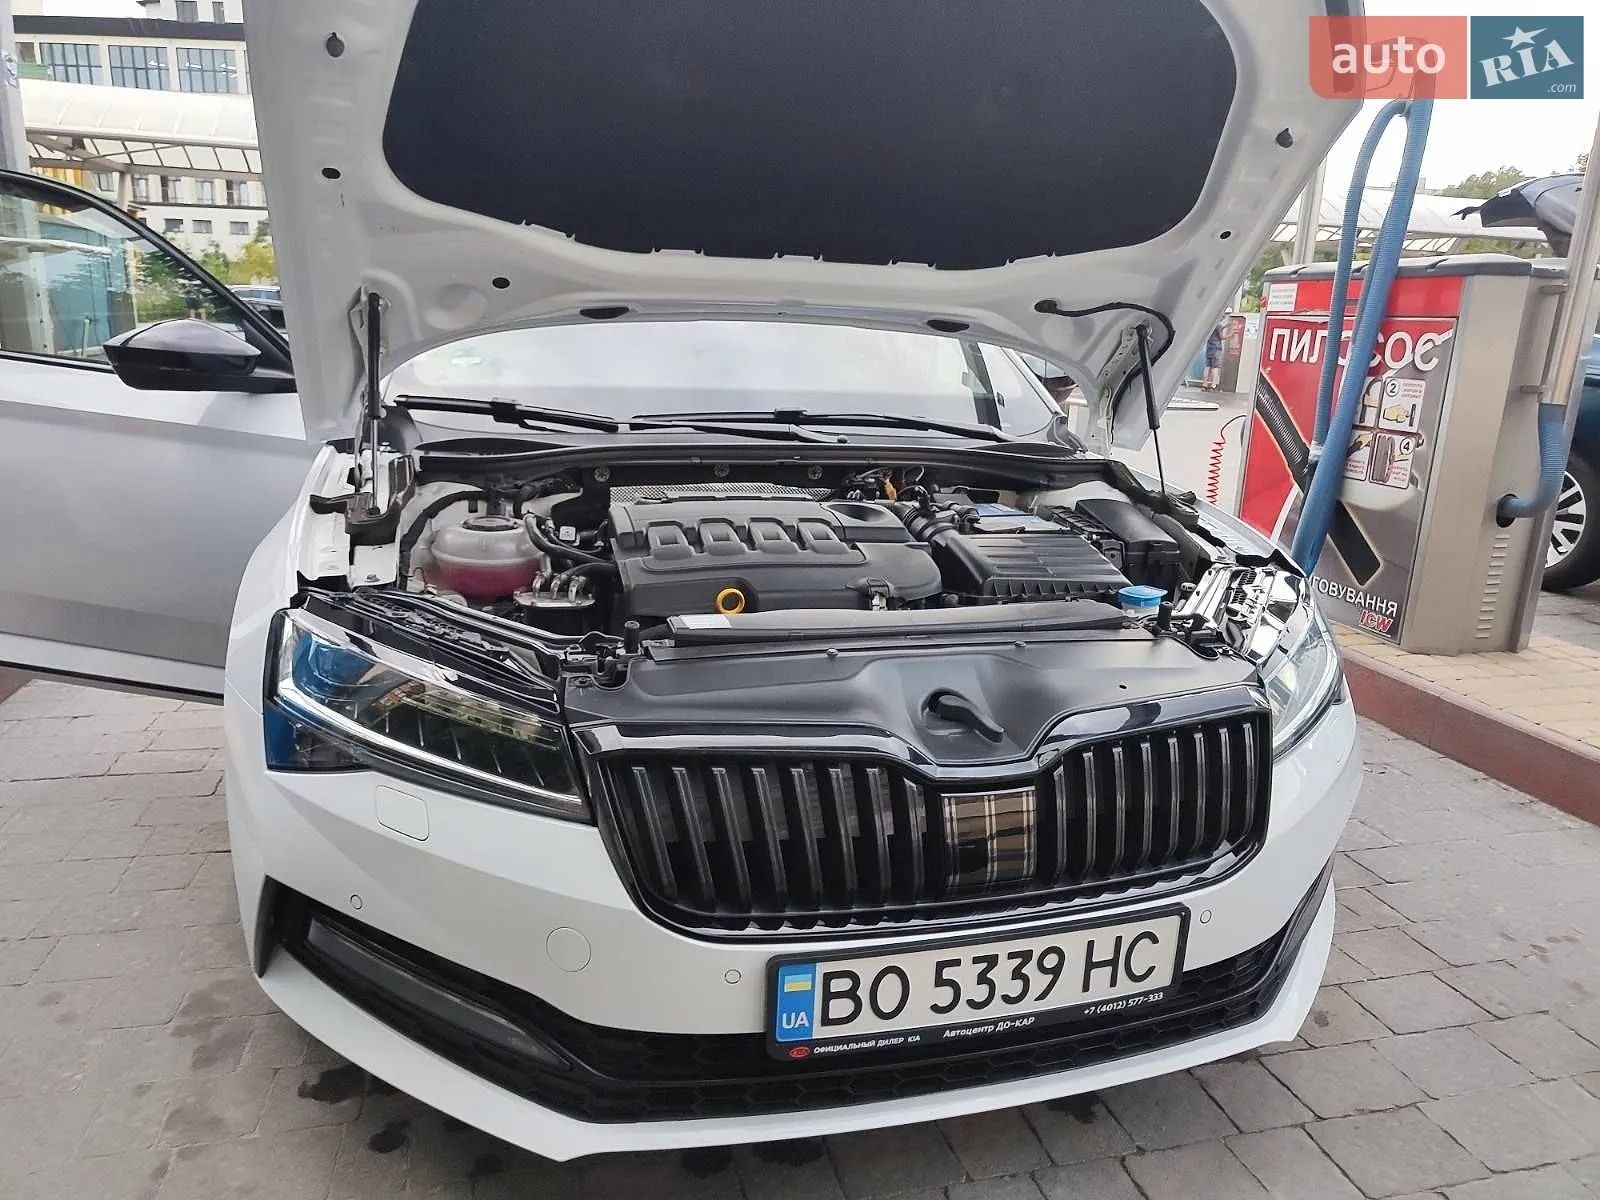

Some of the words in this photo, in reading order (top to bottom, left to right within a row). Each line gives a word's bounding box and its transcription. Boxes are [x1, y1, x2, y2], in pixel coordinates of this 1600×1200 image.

[1389, 383, 1397, 394] 2
[1403, 441, 1410, 452] 4
[1360, 609, 1394, 633] ICW
[820, 965, 911, 1027] BO
[930, 946, 1066, 1014] 5339
[1081, 931, 1160, 993] HC
[1084, 1006, 1096, 1015] +7
[1096, 1000, 1127, 1014] (4012)
[1127, 991, 1164, 1007] 577-333
[782, 1011, 809, 1029] UA
[943, 1024, 995, 1038] Автоцентр
[997, 1016, 1036, 1032] ДО-КАР
[877, 1037, 905, 1047] ДИЛЕР
